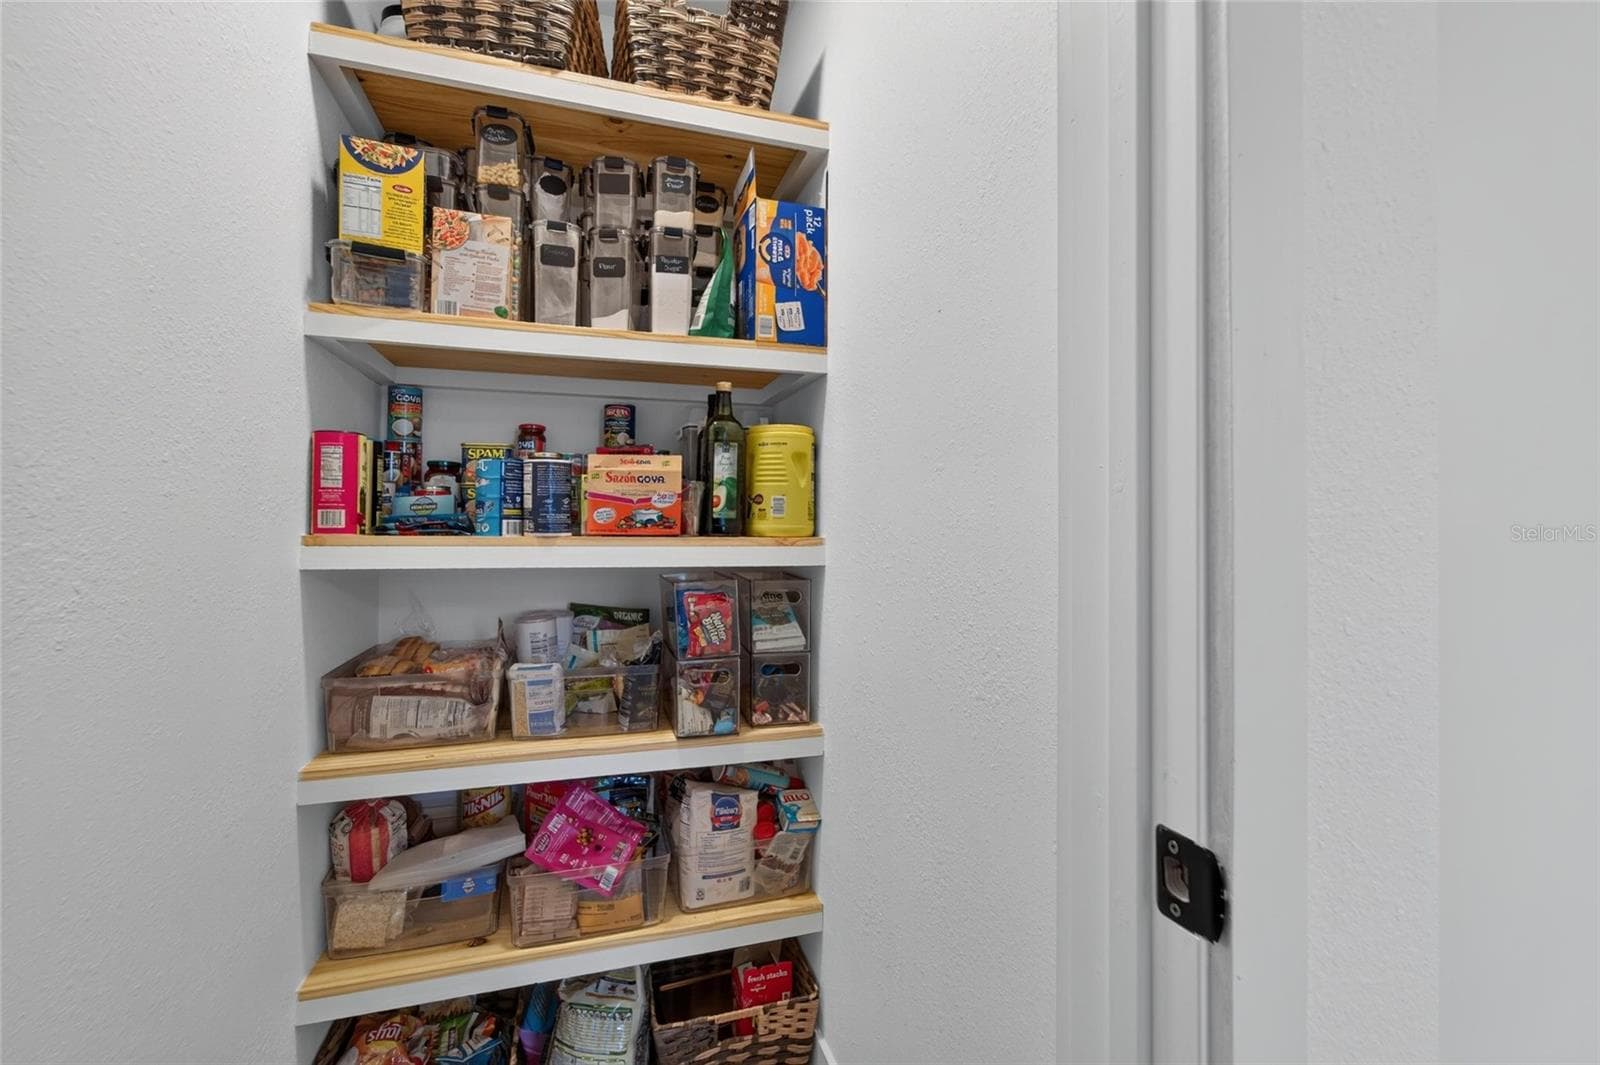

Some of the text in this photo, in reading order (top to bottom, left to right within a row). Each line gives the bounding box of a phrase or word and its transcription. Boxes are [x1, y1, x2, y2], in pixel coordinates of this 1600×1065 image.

[804, 209, 816, 235] pack
[814, 217, 824, 228] 12
[468, 449, 506, 460] SPAM
[605, 471, 637, 484] Sazón
[637, 476, 665, 484] GOYA
[613, 611, 643, 621] ORGANIC
[702, 616, 720, 645] Butter
[710, 612, 727, 641] Nutter
[747, 973, 765, 984] fresh
